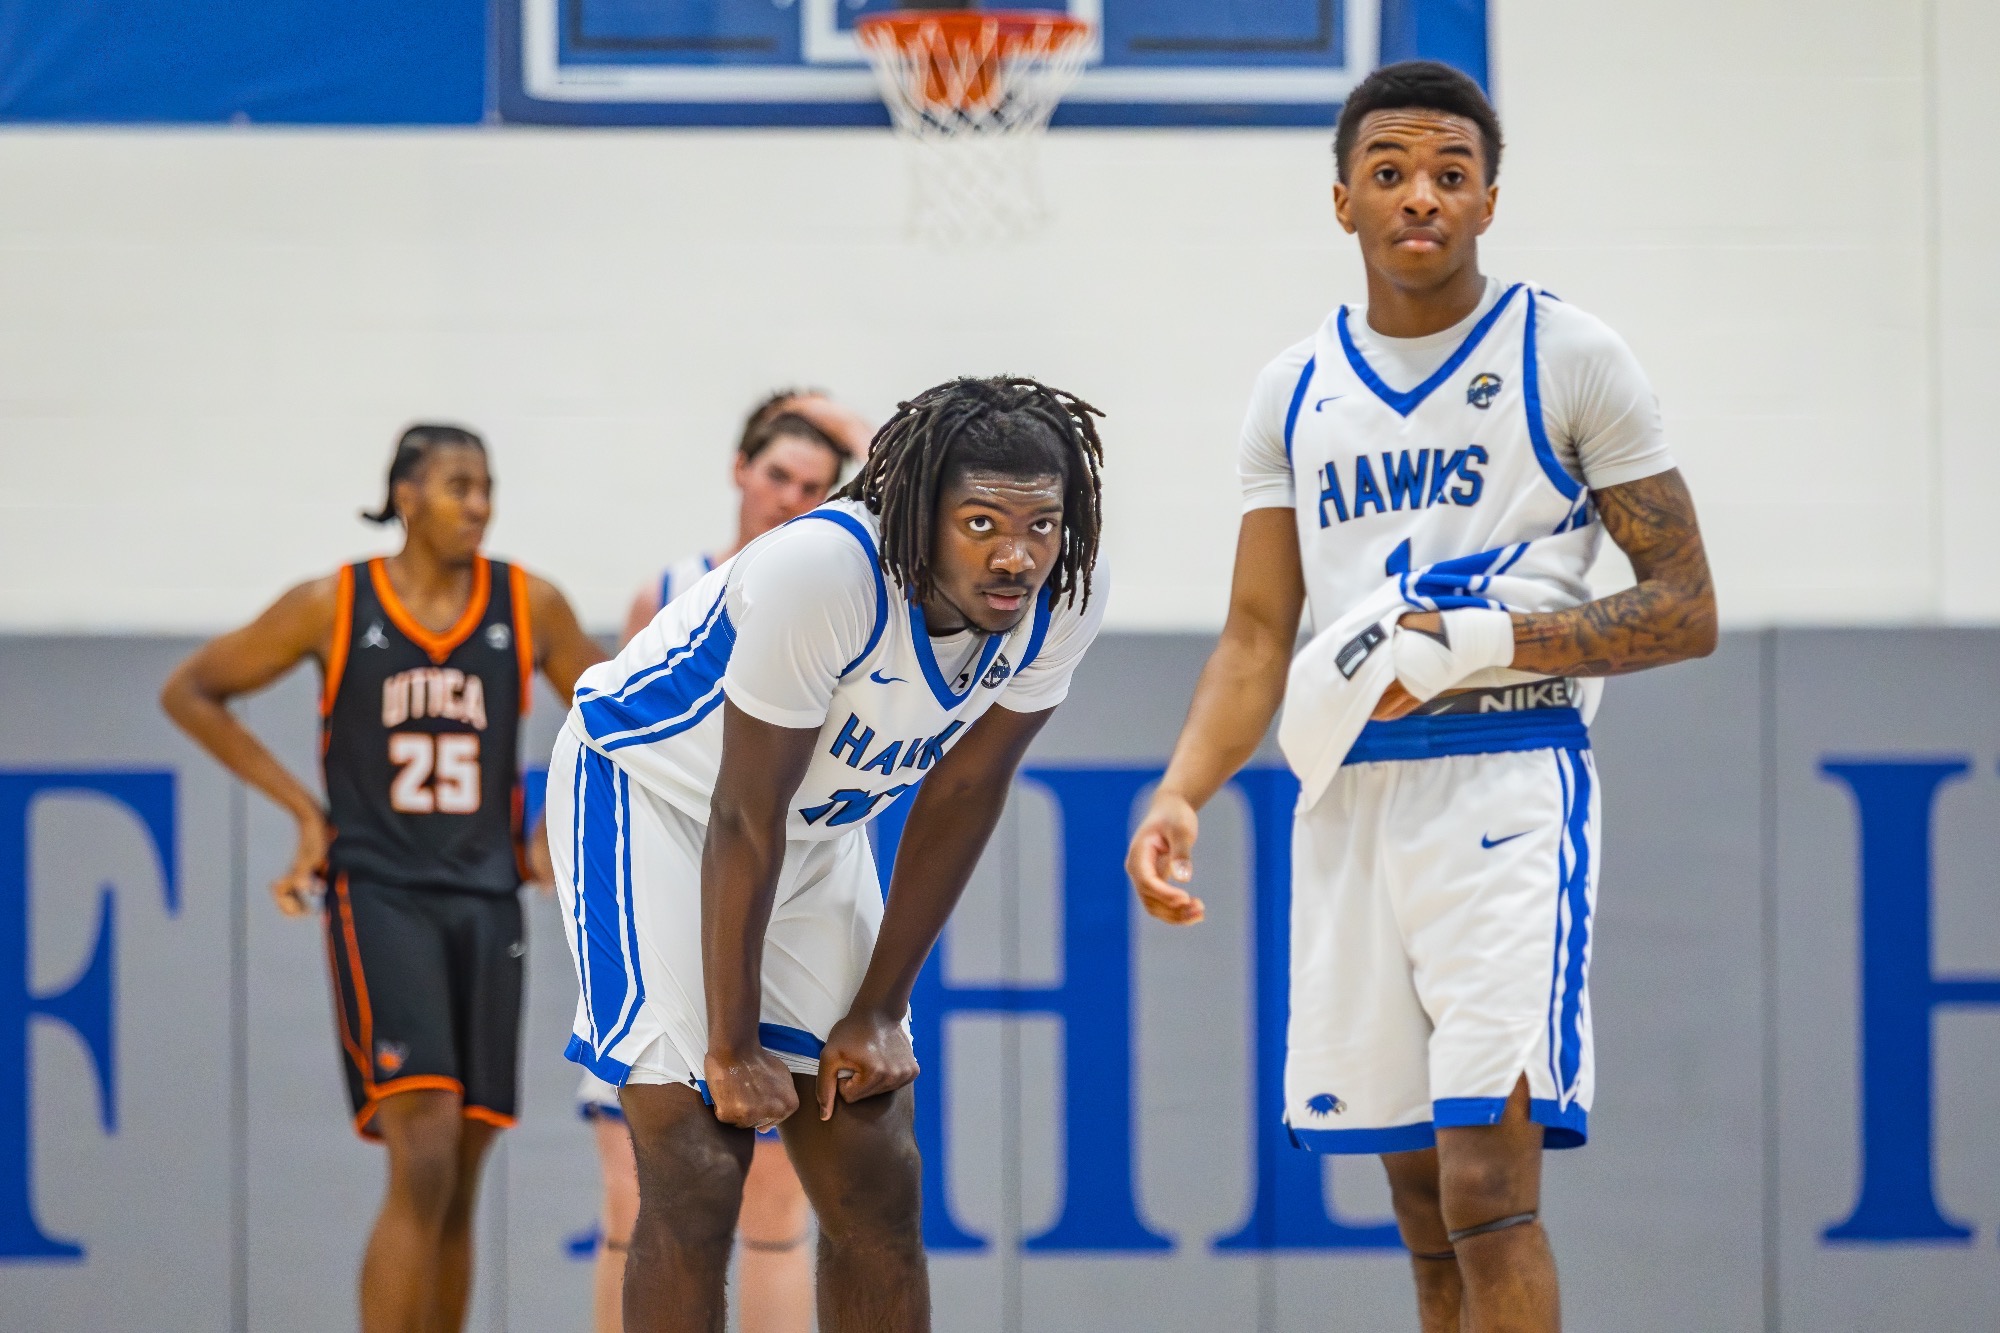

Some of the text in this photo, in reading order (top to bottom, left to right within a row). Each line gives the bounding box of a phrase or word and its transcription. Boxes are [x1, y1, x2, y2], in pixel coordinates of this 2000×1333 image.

[1318, 444, 1489, 529] HAWKS
[1480, 682, 1568, 713] NIKE
[388, 732, 482, 815] 25
